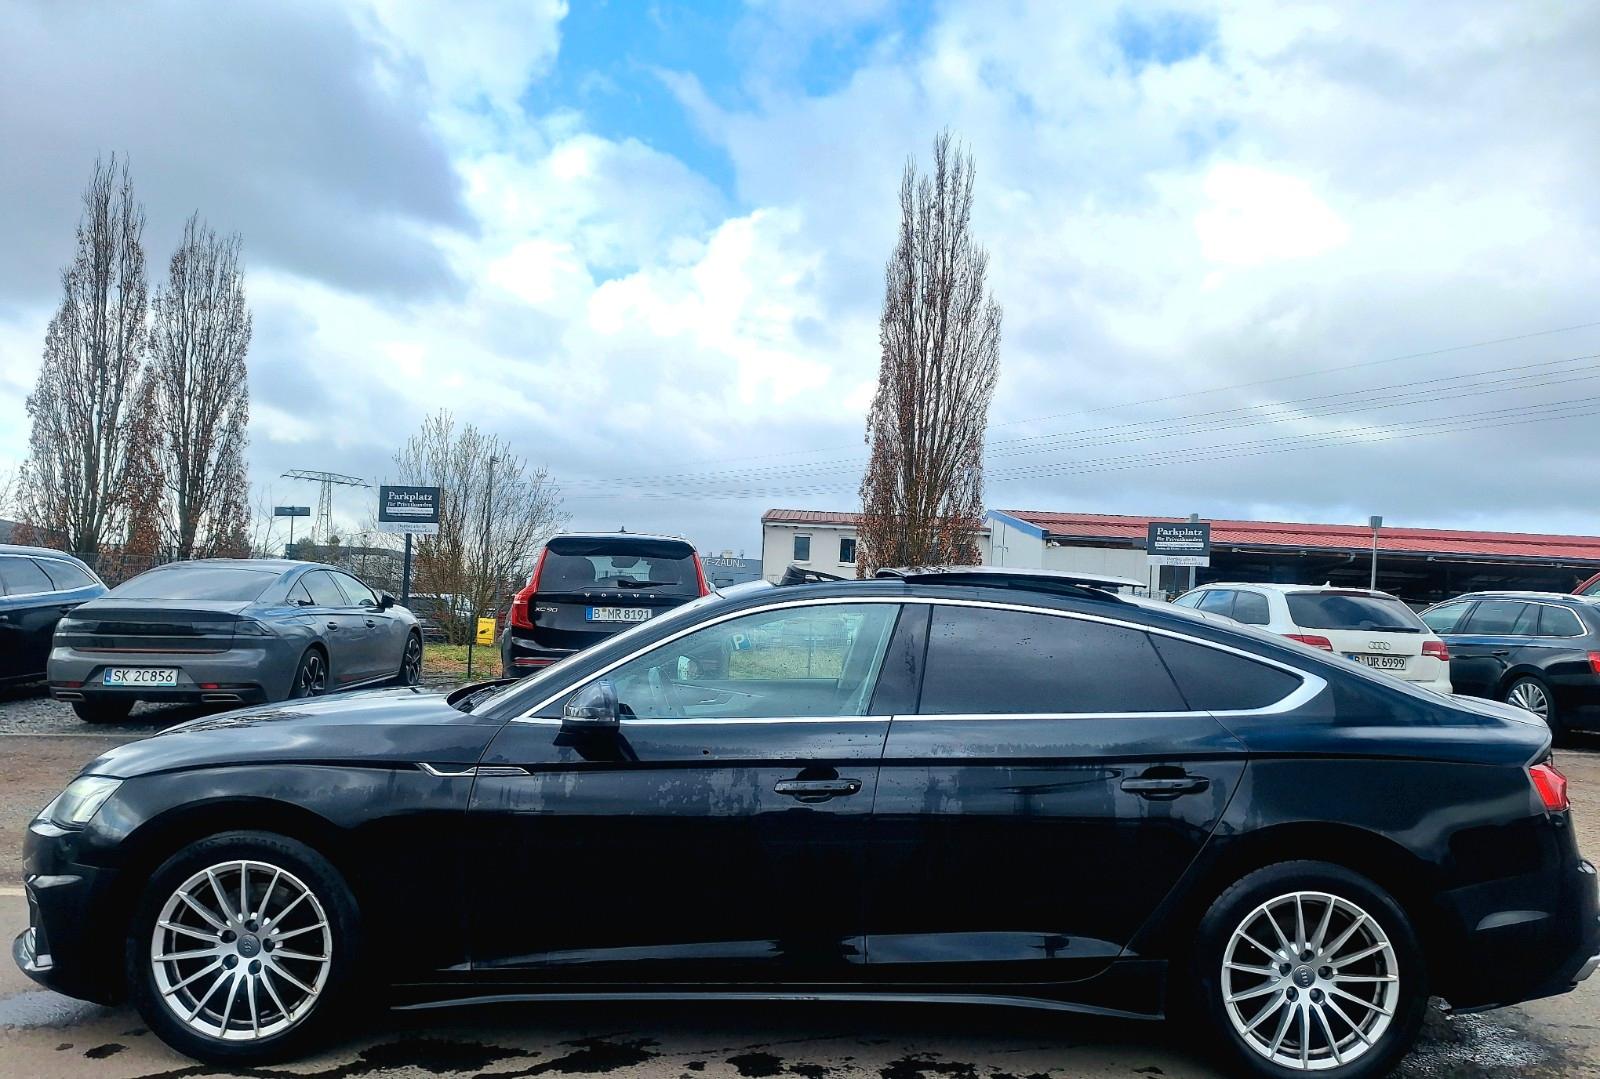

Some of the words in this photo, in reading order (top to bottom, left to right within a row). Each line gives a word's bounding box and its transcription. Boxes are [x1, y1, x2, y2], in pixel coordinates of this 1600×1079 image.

[387, 491, 433, 503] Parkplatz
[1156, 527, 1203, 538] Parkplatz
[593, 608, 601, 619] B
[607, 609, 622, 620] MR
[624, 609, 650, 620] 8191
[1366, 656, 1380, 667] UR
[1381, 657, 1405, 668] 6999
[113, 670, 130, 682] SK
[133, 670, 174, 682] 2C856
